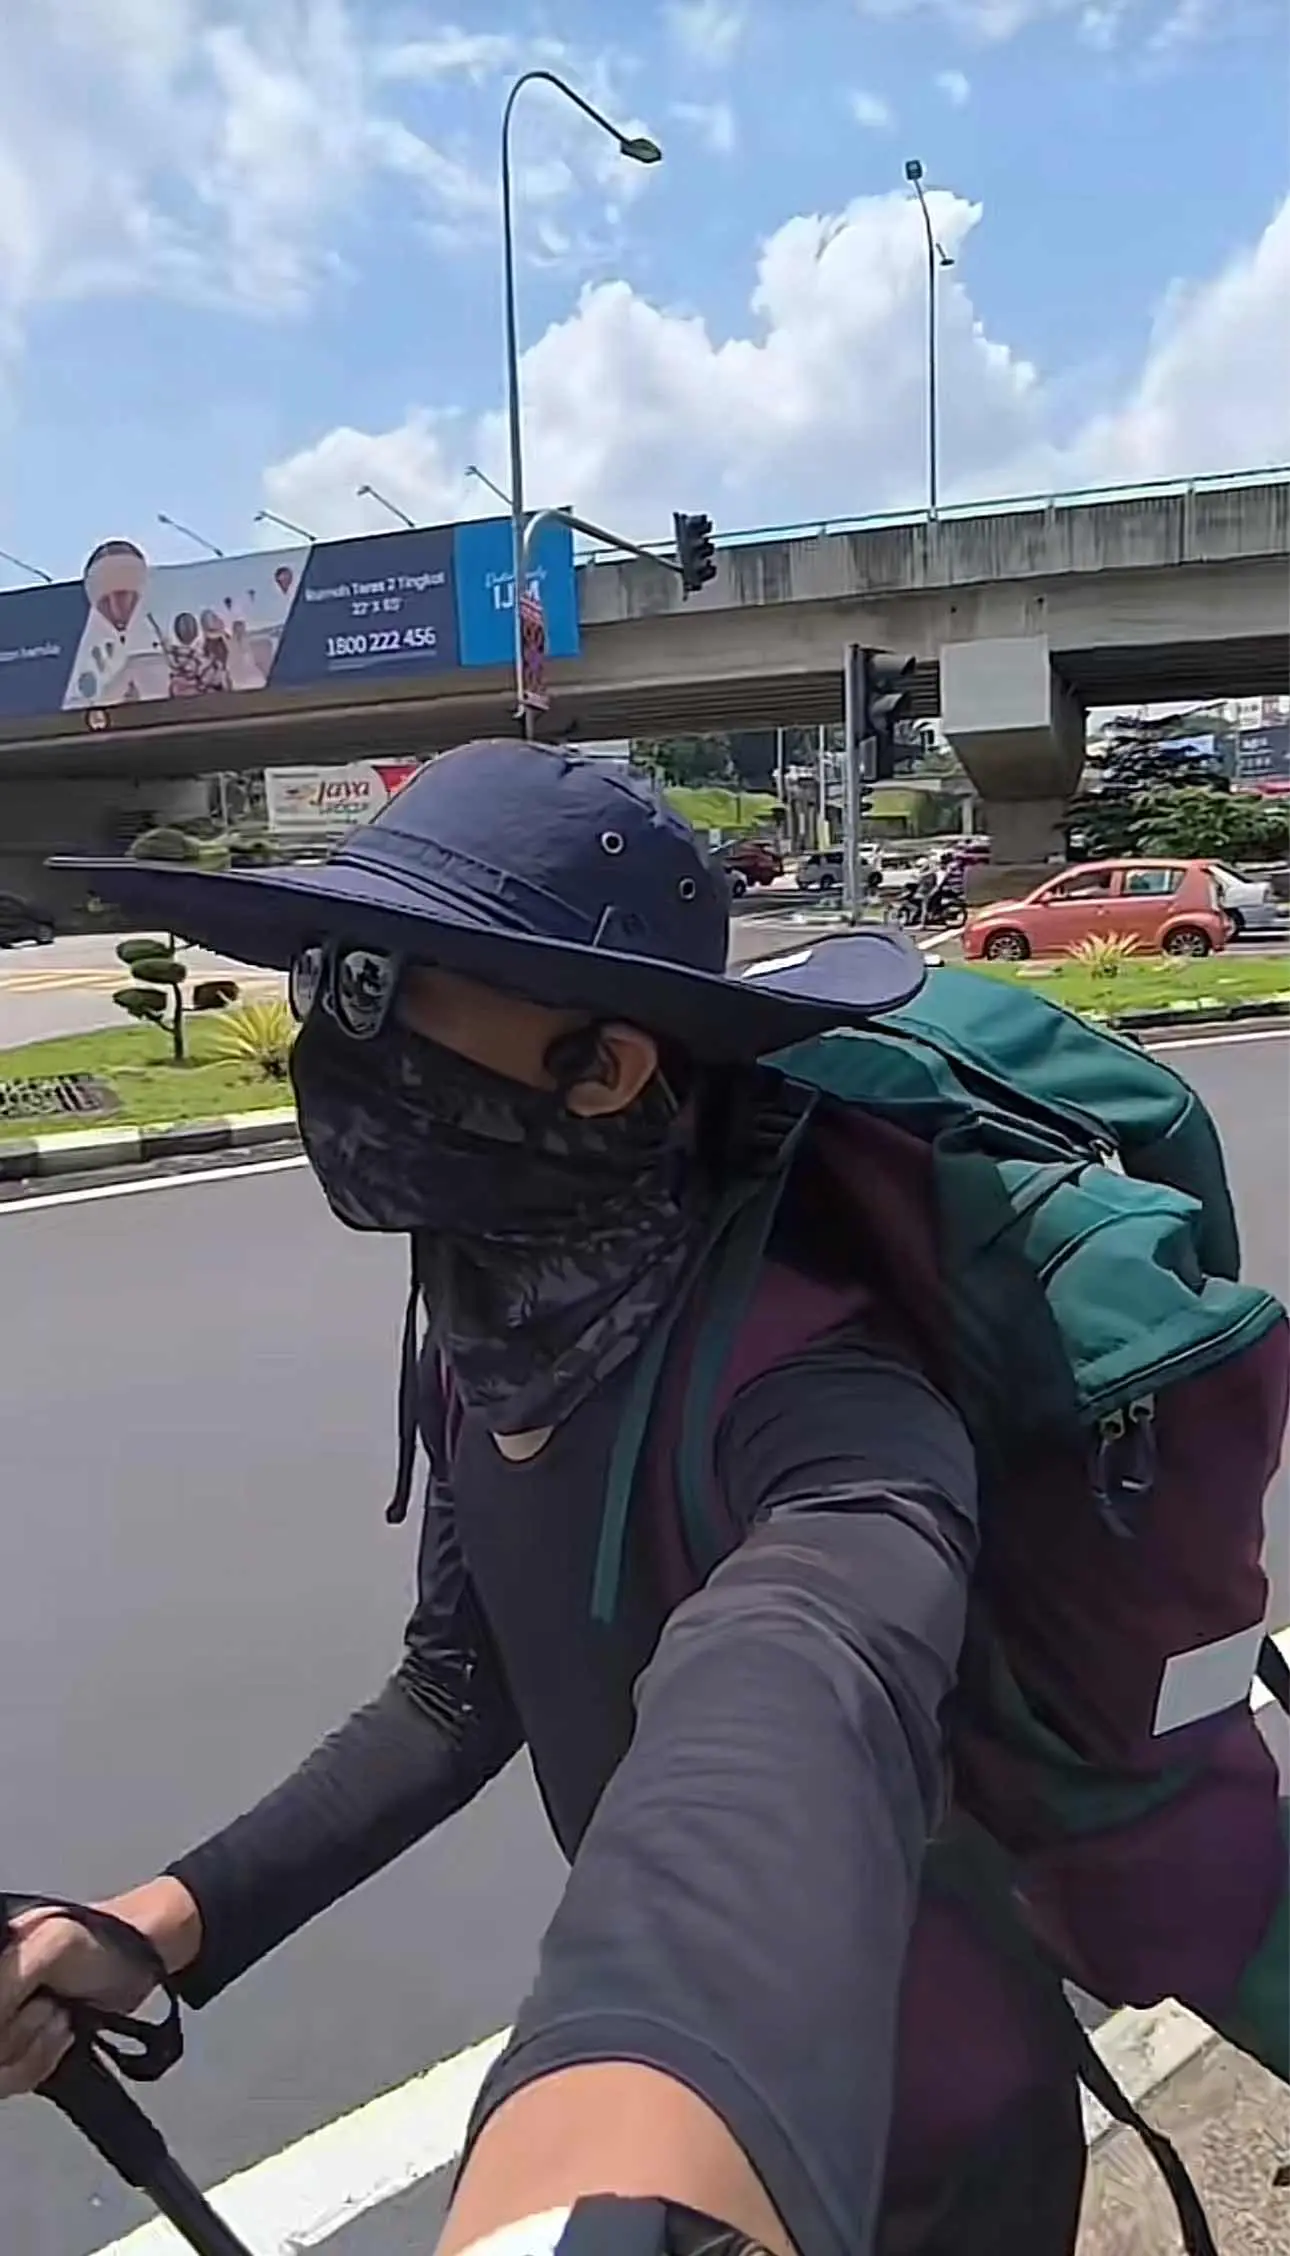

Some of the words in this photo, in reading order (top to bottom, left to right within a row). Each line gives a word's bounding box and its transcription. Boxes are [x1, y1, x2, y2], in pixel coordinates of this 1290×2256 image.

[327, 635, 367, 657] 1800
[368, 630, 401, 652] 222
[403, 626, 436, 647] 456
